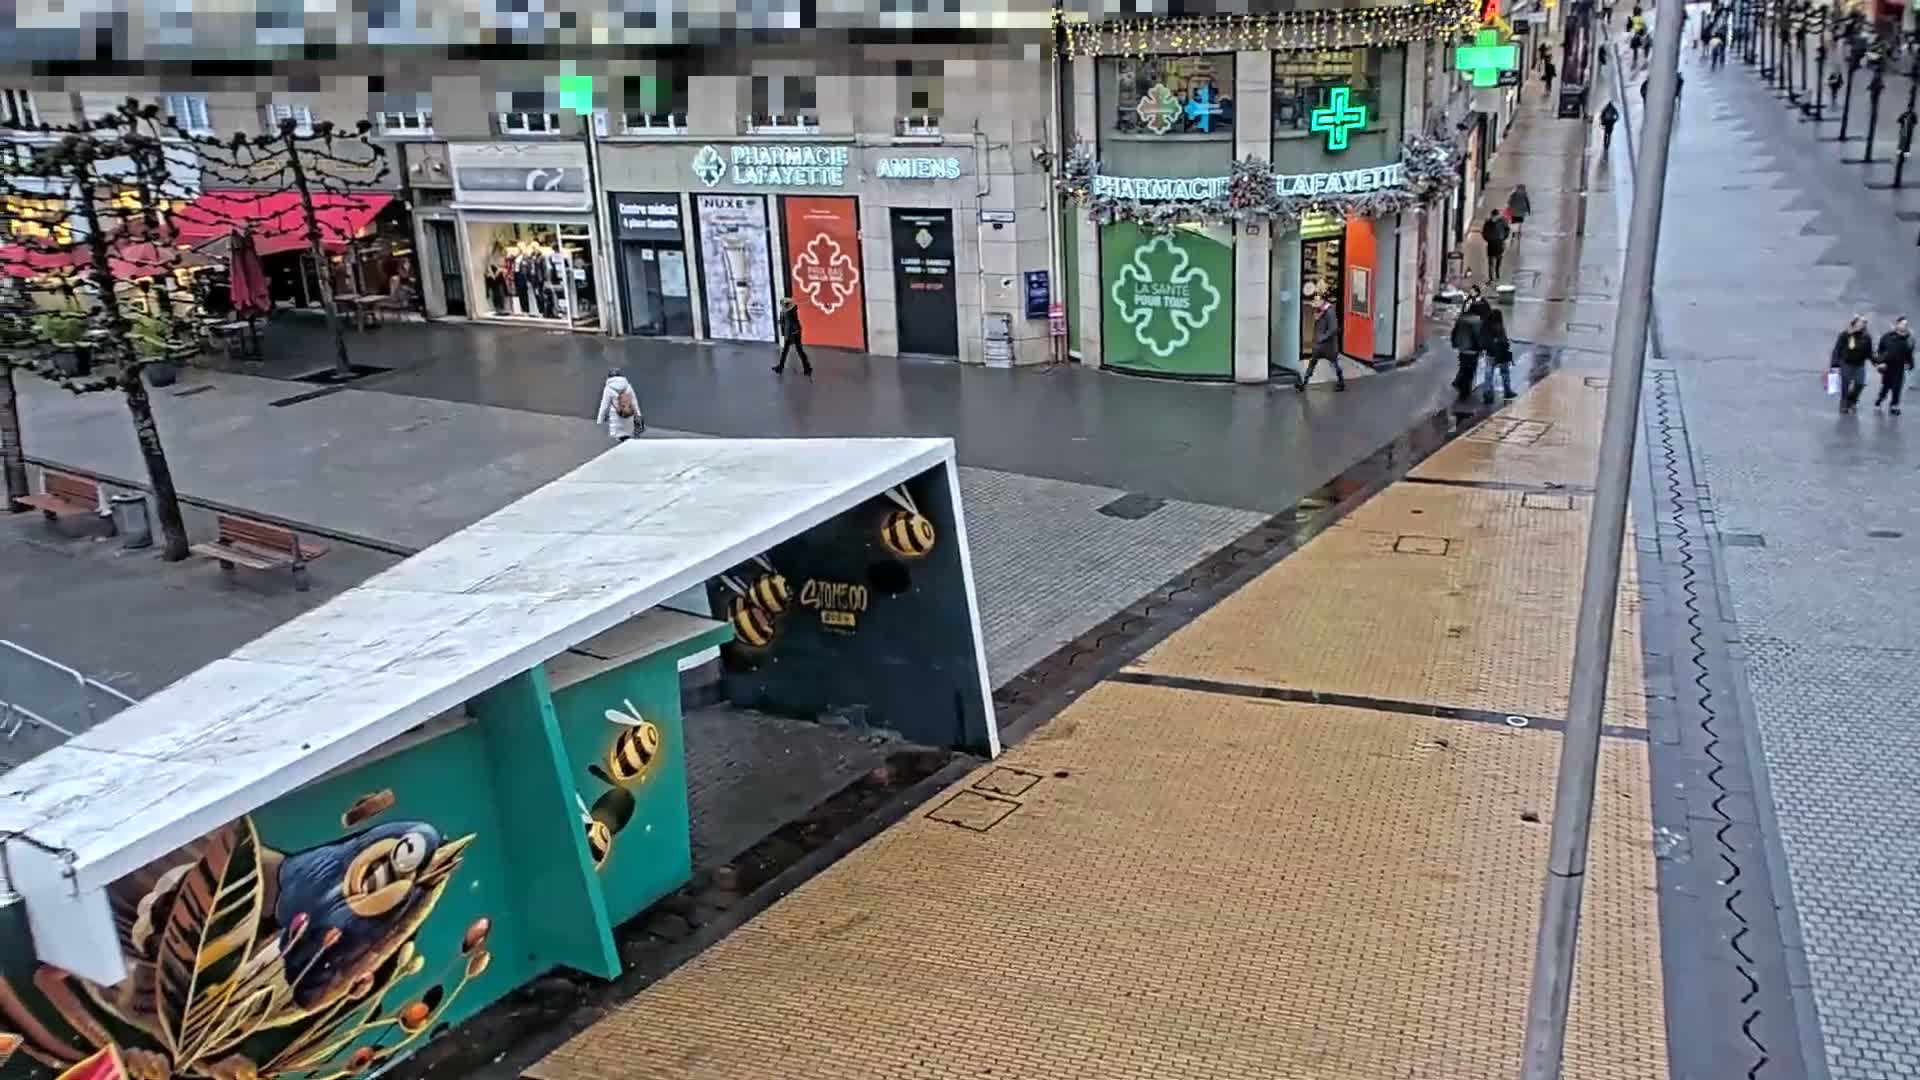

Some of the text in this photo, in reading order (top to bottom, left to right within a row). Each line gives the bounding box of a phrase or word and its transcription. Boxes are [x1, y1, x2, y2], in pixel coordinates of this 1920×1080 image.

[731, 146, 848, 165] PHARMACIE
[733, 165, 844, 186] LAFAYETTE
[877, 157, 960, 179] AMIENS
[704, 199, 744, 209] NUXE
[1136, 282, 1150, 294] LA
[1164, 296, 1190, 309] TOUS
